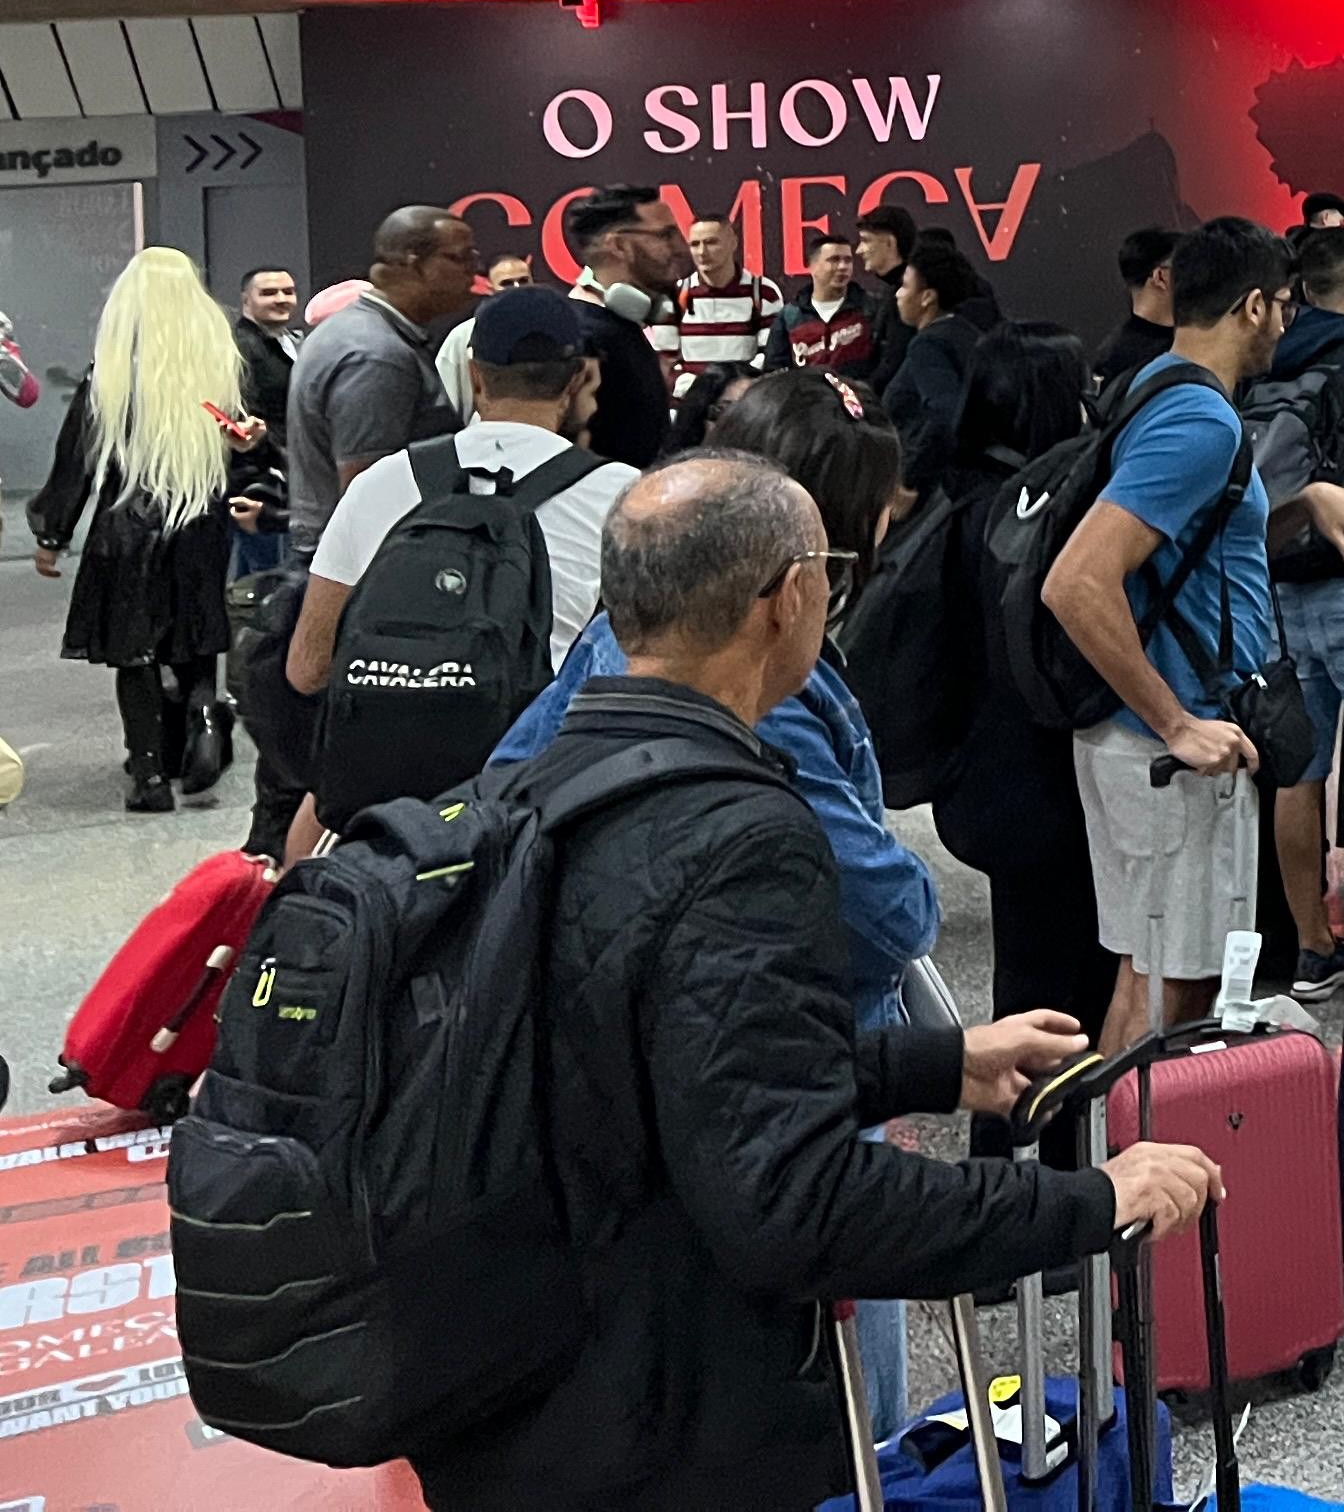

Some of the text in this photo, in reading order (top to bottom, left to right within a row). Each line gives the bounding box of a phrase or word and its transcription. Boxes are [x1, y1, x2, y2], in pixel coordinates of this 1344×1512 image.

[542, 73, 941, 159] O SHOW
[0, 140, 122, 178] nçado
[347, 659, 476, 688] CAVALERA
